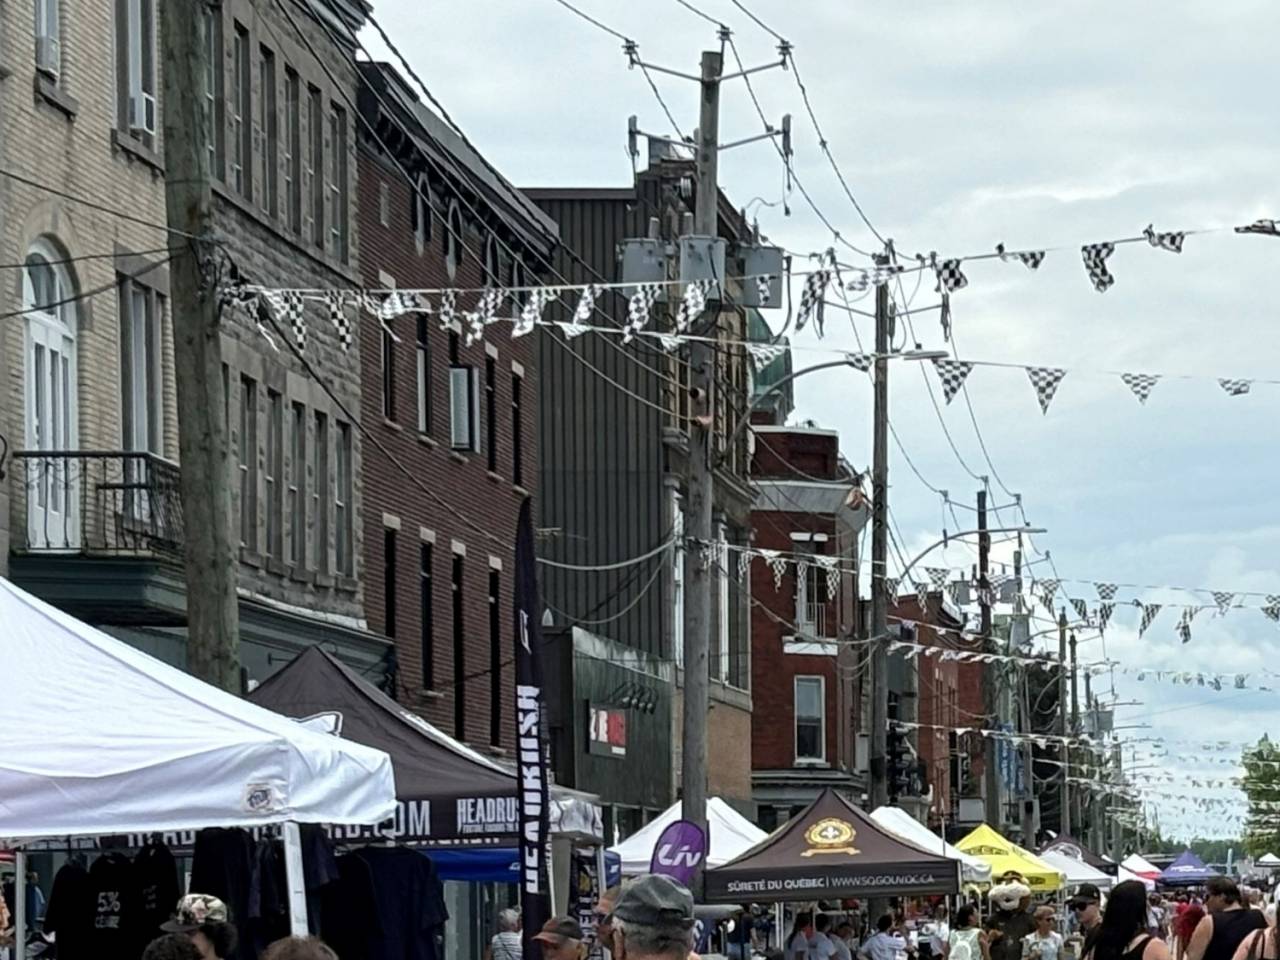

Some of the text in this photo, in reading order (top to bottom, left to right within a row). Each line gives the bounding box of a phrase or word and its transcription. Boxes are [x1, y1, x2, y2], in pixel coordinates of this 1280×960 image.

[658, 844, 701, 867] Liv
[727, 878, 765, 892] SÛRETÉ
[767, 879, 782, 890] DU
[784, 877, 825, 889] QUÉBEC
